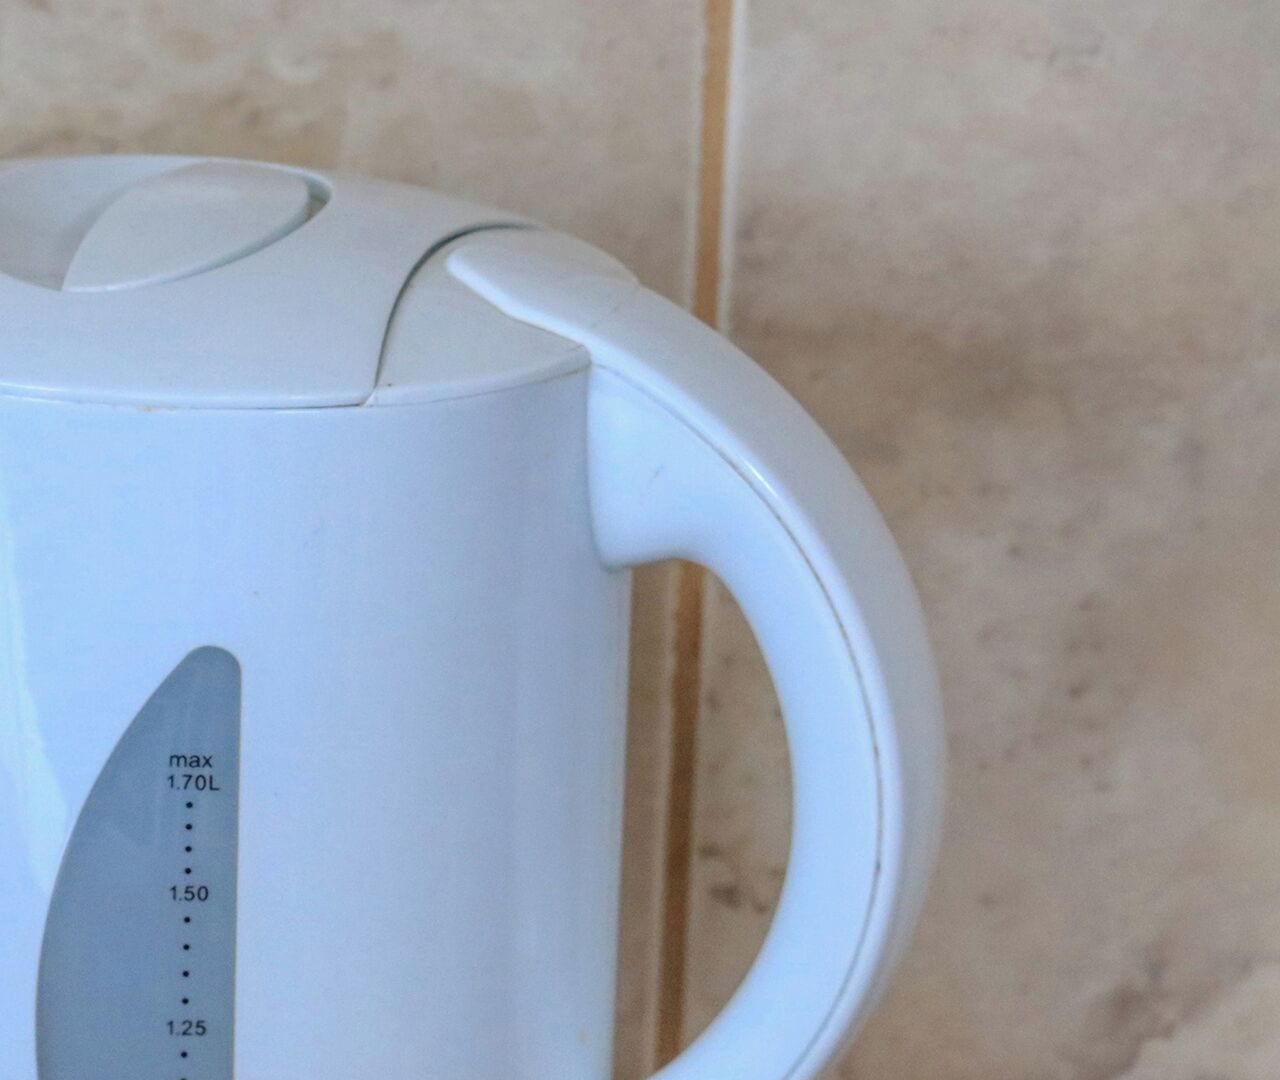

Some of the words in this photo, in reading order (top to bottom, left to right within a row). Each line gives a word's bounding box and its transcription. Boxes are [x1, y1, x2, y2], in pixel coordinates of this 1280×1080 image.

[169, 754, 212, 768] max
[167, 774, 219, 791] 1.70L
[169, 886, 208, 902] 1.50
[166, 1021, 206, 1036] 1.25
